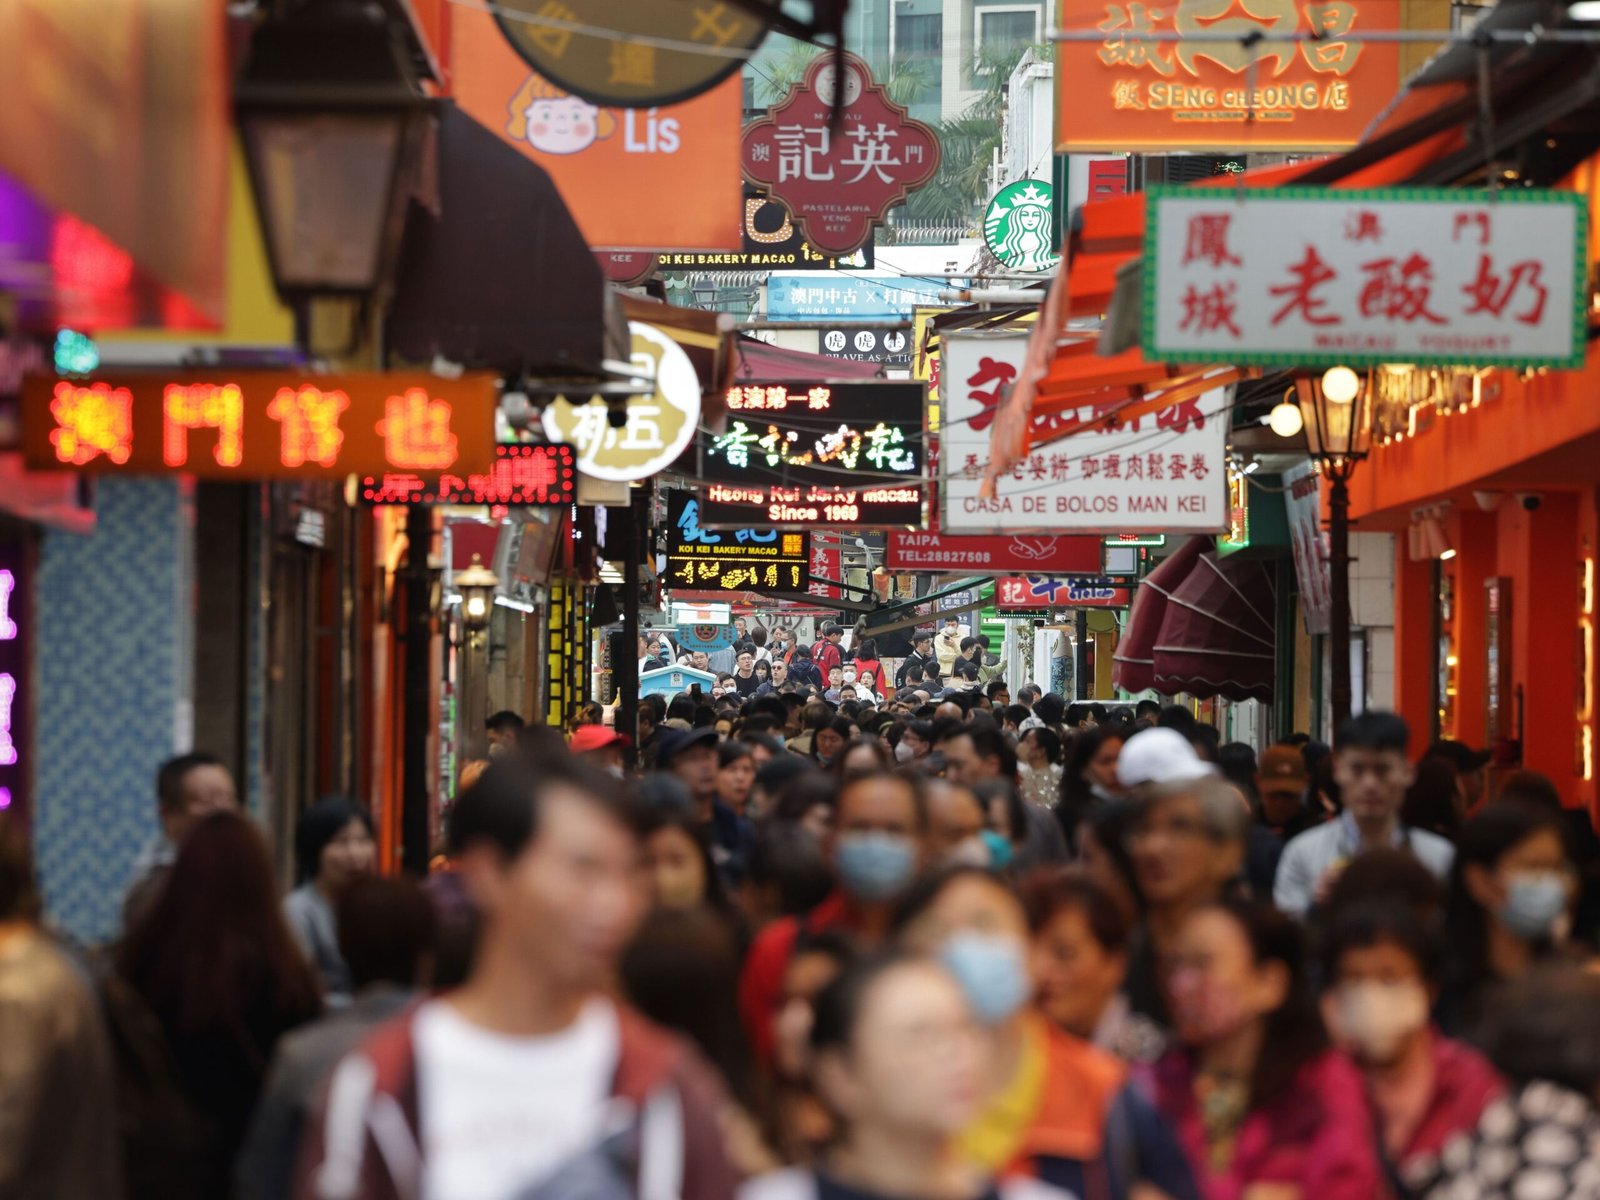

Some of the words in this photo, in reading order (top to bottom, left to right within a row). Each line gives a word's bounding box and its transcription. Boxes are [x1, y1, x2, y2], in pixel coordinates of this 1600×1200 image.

[1148, 83, 1216, 110] SENG
[1222, 82, 1320, 110] CHEONG
[1324, 82, 1348, 110] 店
[752, 144, 770, 162] 澳
[905, 145, 922, 163] 門
[803, 204, 871, 212] PASTELARIA
[822, 214, 852, 222] YENG
[610, 254, 632, 263] KEE
[674, 254, 695, 264] KEI
[698, 254, 748, 264] BAKERY
[751, 254, 796, 264] MACAO
[1268, 243, 1549, 328] 老酸奶
[790, 287, 857, 305] 澳門中古
[868, 354, 881, 362] AS
[885, 354, 892, 363] A
[963, 496, 1013, 513] CASA
[1022, 496, 1047, 513] DE
[1056, 496, 1119, 513] BOLOS
[1128, 496, 1168, 513] MAN
[1177, 496, 1207, 513] KEI
[769, 504, 818, 521] Since
[824, 504, 859, 521] 1969
[898, 534, 941, 546] TAIPA
[678, 545, 694, 553] KOI
[696, 545, 711, 554] KEI
[713, 546, 747, 555] BAKERY
[748, 546, 778, 556] MACAO
[897, 550, 991, 563] TEL:28827508
[1003, 580, 1026, 603] 記
